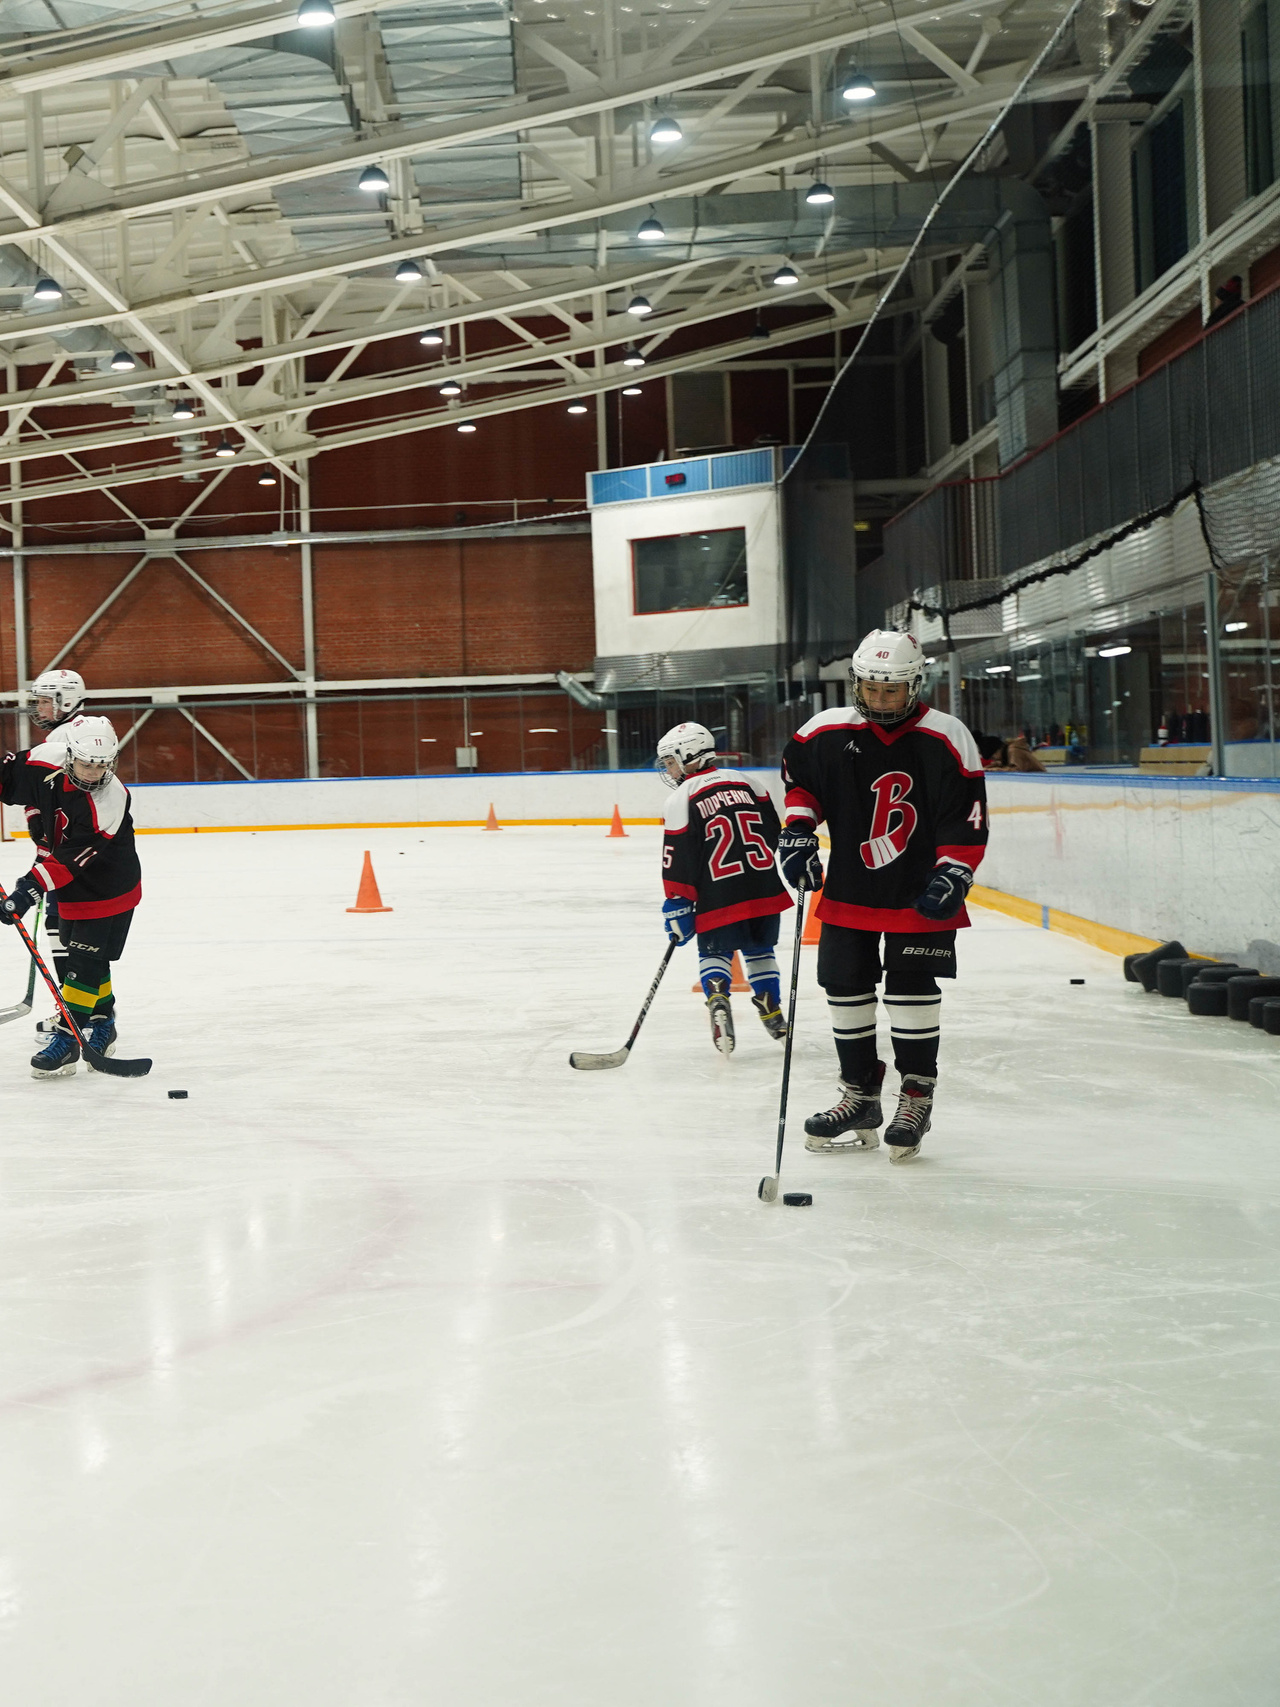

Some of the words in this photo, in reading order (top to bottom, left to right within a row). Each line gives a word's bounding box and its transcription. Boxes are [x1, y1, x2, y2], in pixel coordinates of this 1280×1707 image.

[876, 650, 890, 660] 40
[95, 738, 102, 746] 11
[704, 811, 774, 882] 25
[778, 837, 817, 848] AUER
[69, 940, 100, 953] CCM
